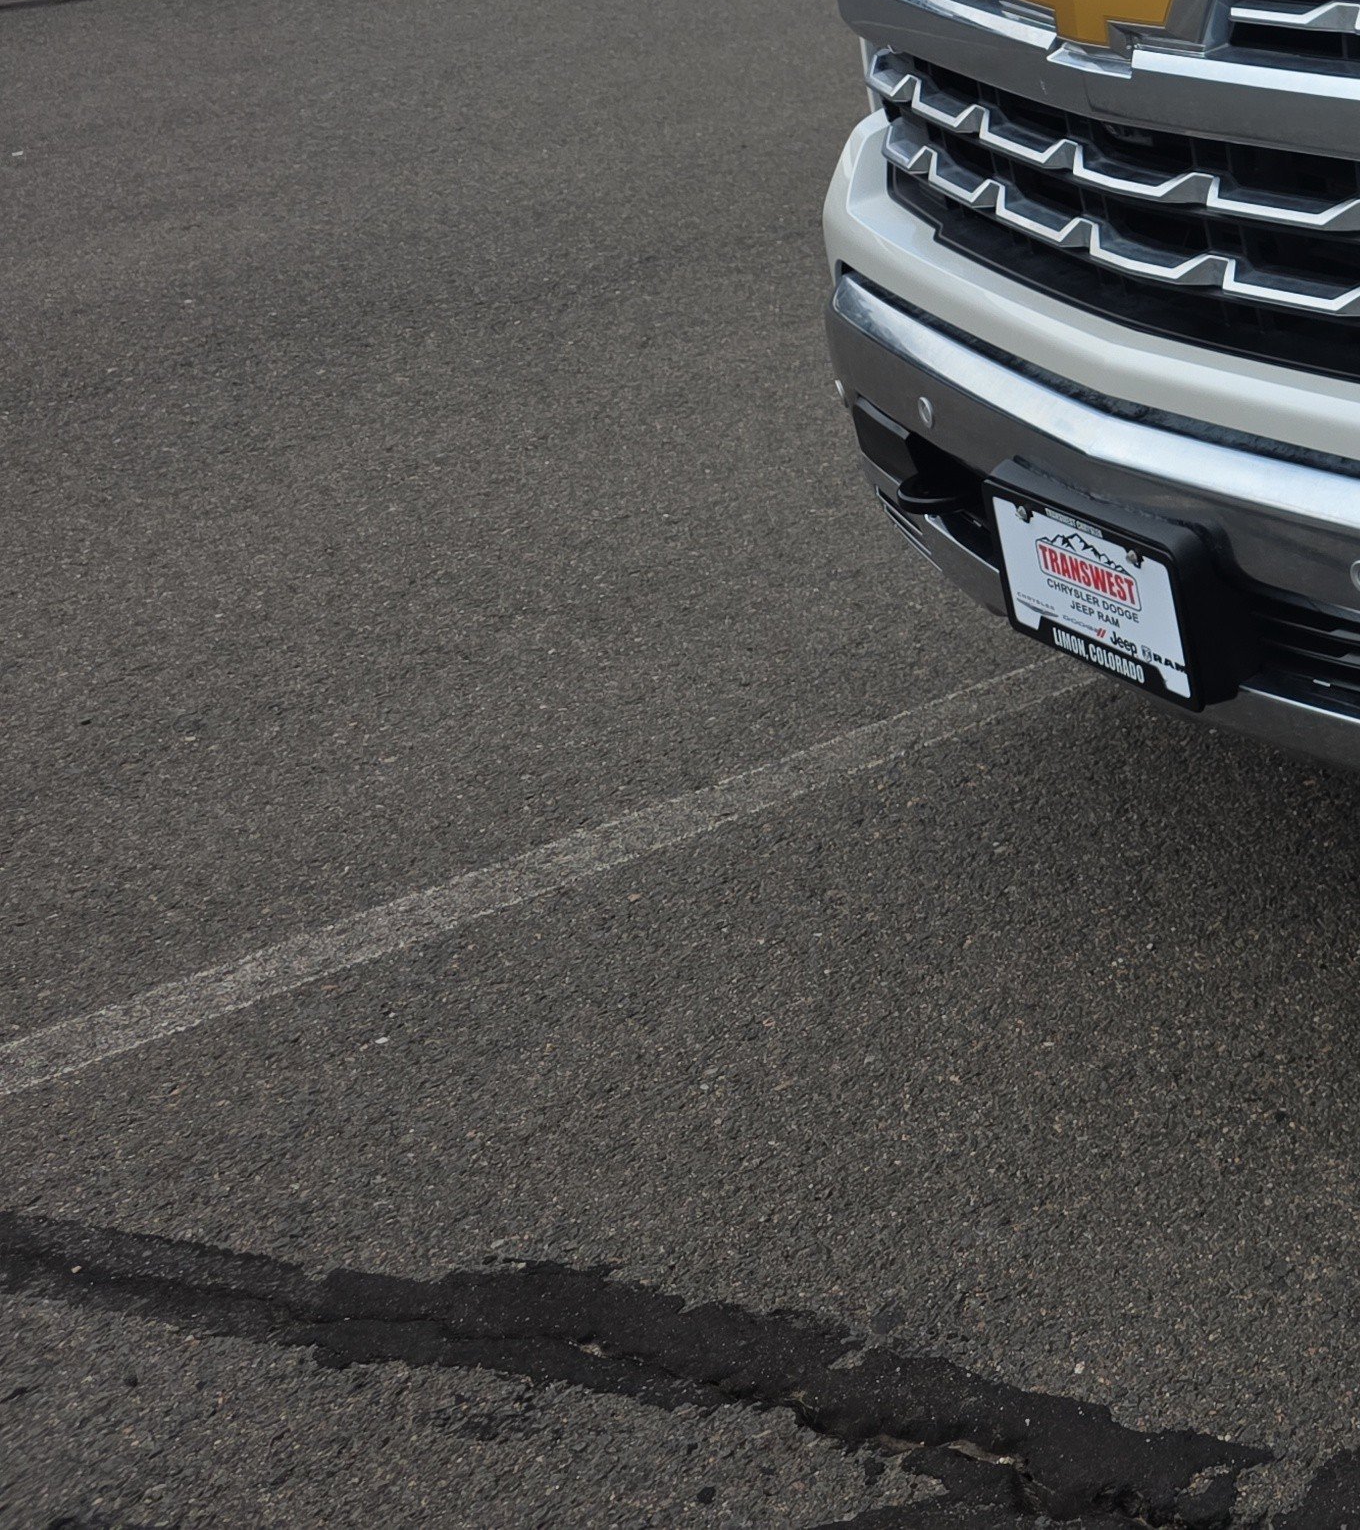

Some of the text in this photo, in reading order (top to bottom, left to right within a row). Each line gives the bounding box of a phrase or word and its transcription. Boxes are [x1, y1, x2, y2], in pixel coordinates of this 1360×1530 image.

[1038, 543, 1137, 605] TRANSWEST
[1046, 578, 1140, 624] CHRYSLER DODGE
[1069, 600, 1121, 628] JEEP RAM
[1052, 626, 1146, 684] LIMON, COLORADO
[1110, 631, 1138, 657] Jeep
